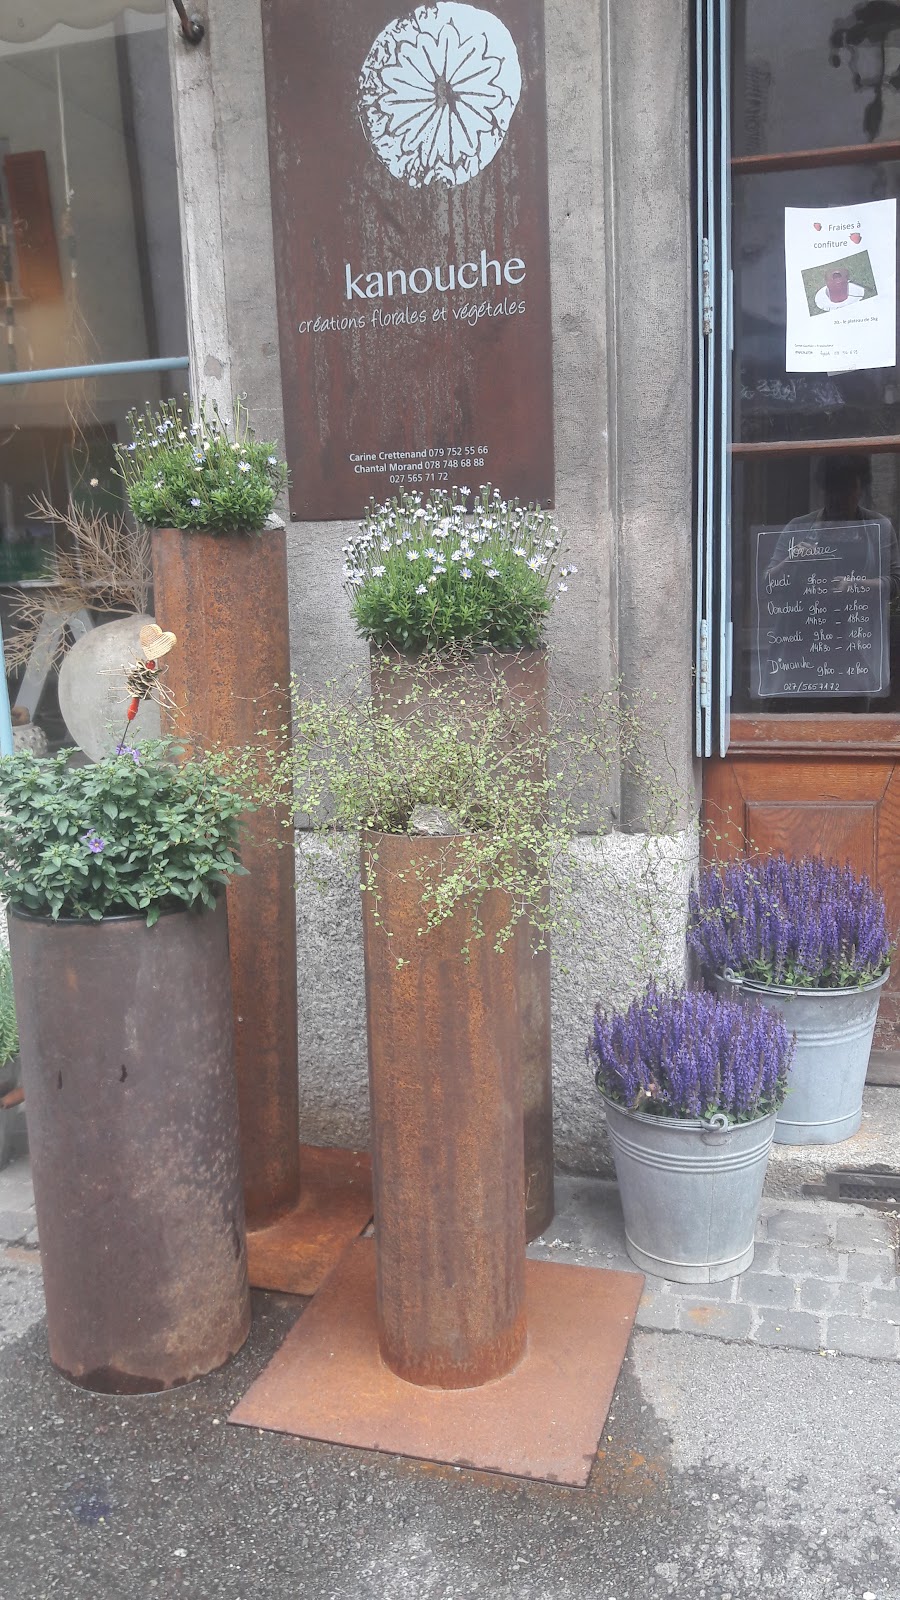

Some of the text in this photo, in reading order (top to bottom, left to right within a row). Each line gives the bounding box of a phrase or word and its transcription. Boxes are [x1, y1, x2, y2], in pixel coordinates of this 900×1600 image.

[828, 220, 861, 232] Fraises à
[813, 240, 848, 249] confiture
[345, 249, 526, 300] kanouche
[298, 298, 526, 334] créations florales et végétales
[349, 445, 489, 462] Carine Crettenand 079 752 55 66
[354, 457, 485, 474] Chantal Morand 078 748 68 88
[389, 472, 449, 484] 027 565 71 72
[788, 537, 838, 559] Horaire
[766, 573, 791, 594] Jeudi
[807, 573, 828, 586] 9h00
[843, 570, 867, 582] 12h00
[803, 585, 828, 596] 14h30
[808, 600, 828, 615] 9h00
[844, 599, 869, 611] 12h00
[805, 616, 827, 625] 14h30
[847, 612, 870, 623] 18h30
[766, 631, 804, 644] Samedi
[813, 628, 834, 641] 9h00
[848, 627, 872, 638] 12h00
[809, 642, 831, 653] 14h30
[845, 641, 872, 651] 17h00
[766, 657, 815, 674] Dimanche
[817, 662, 835, 677] 9h00
[846, 661, 869, 675] 12h00
